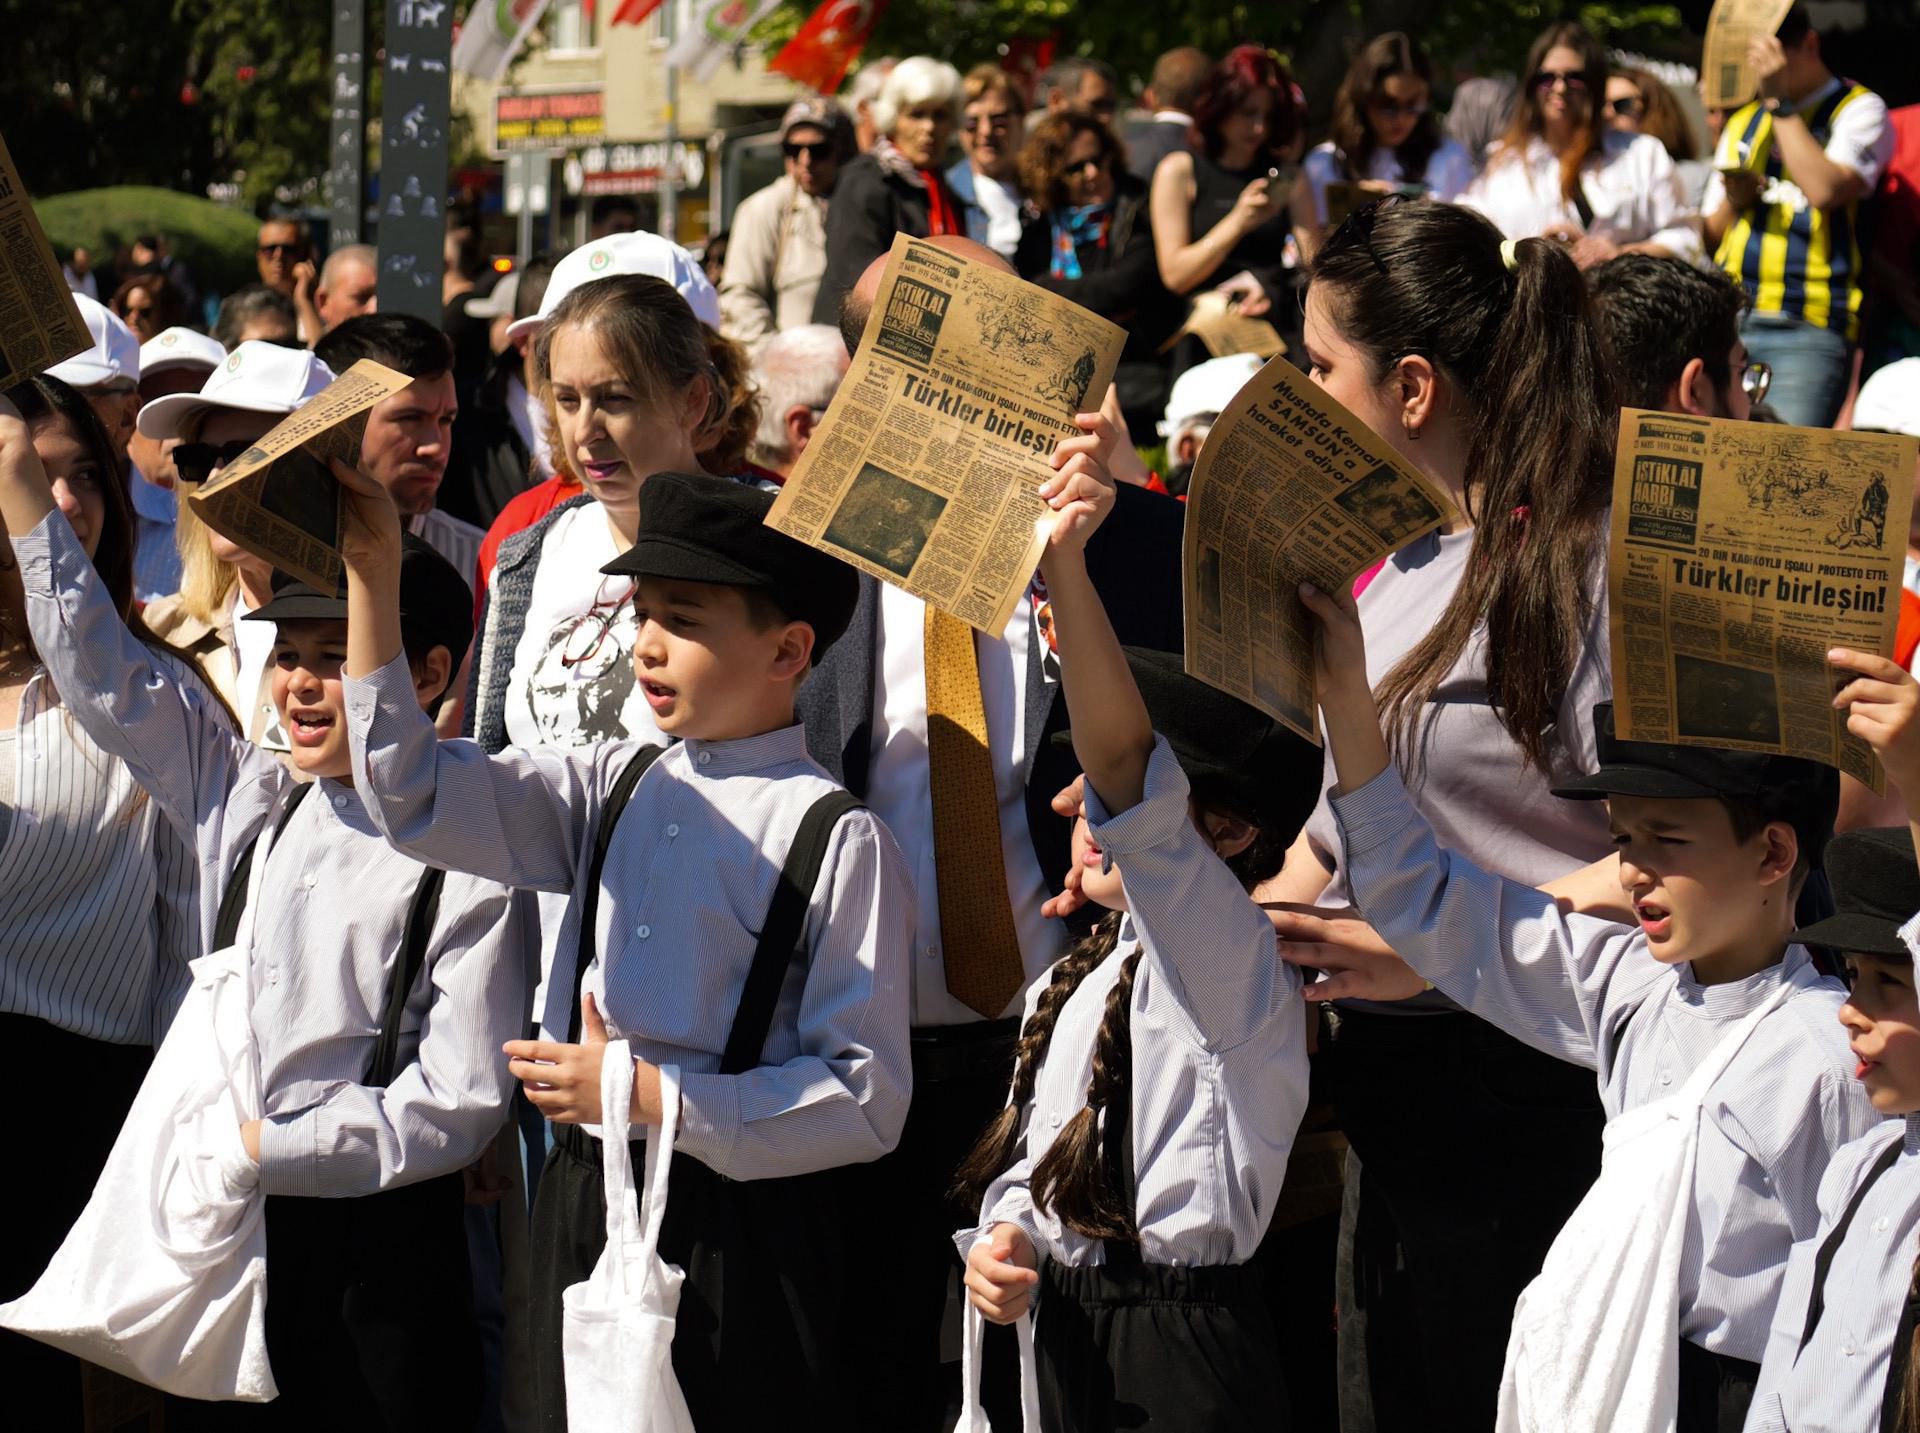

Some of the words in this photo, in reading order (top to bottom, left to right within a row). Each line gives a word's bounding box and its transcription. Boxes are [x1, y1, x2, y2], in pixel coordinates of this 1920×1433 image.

[901, 373, 983, 425] Türkler
[983, 408, 1059, 456] birleşi
[930, 368, 940, 379] 20
[1023, 407, 1061, 430] PROTESTO
[1272, 380, 1332, 428] Mustafa
[1332, 426, 1383, 467] Kemal
[1246, 403, 1304, 448] hareket
[1304, 449, 1353, 485] ediyor
[1672, 558, 1770, 598] Türkler
[1776, 575, 1887, 616] birleşin!
[1698, 547, 1709, 558] 20
[1818, 564, 1863, 580] PROTESTO
